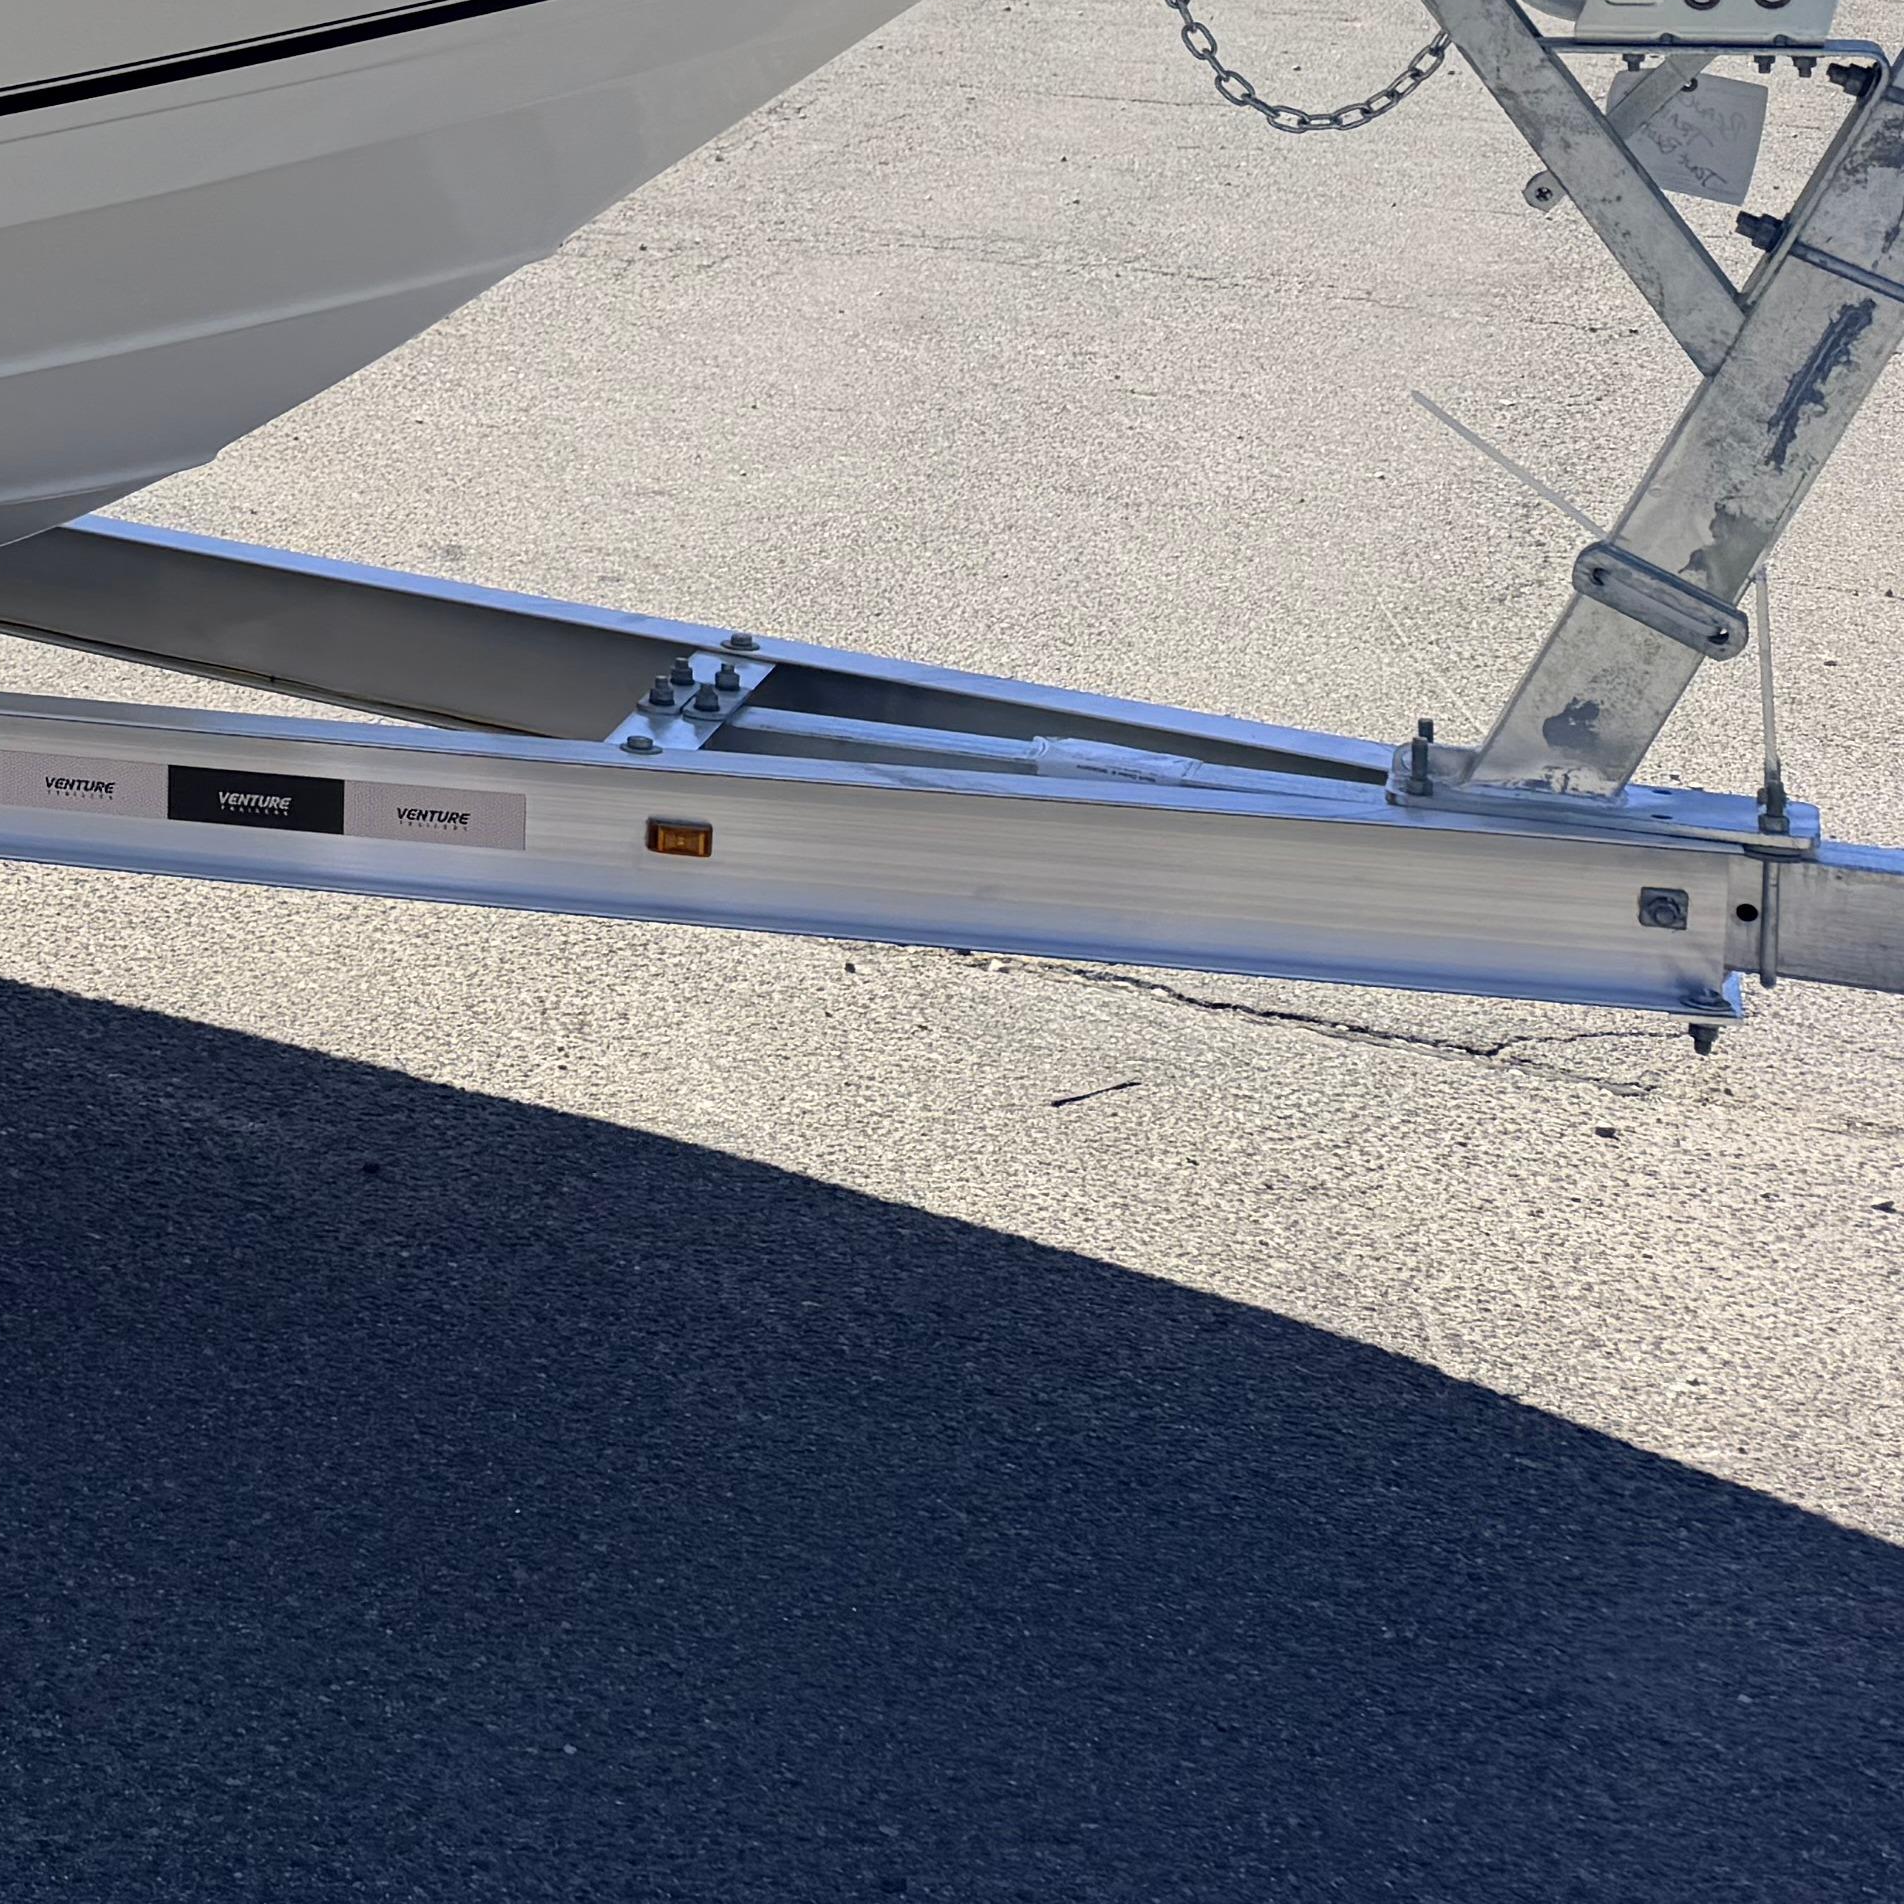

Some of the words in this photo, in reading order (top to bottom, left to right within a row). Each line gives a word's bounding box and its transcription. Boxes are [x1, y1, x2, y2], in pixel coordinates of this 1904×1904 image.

[45, 776, 115, 794] VENTURE
[218, 791, 292, 810] VENTURE
[396, 807, 471, 825] VENTURE
